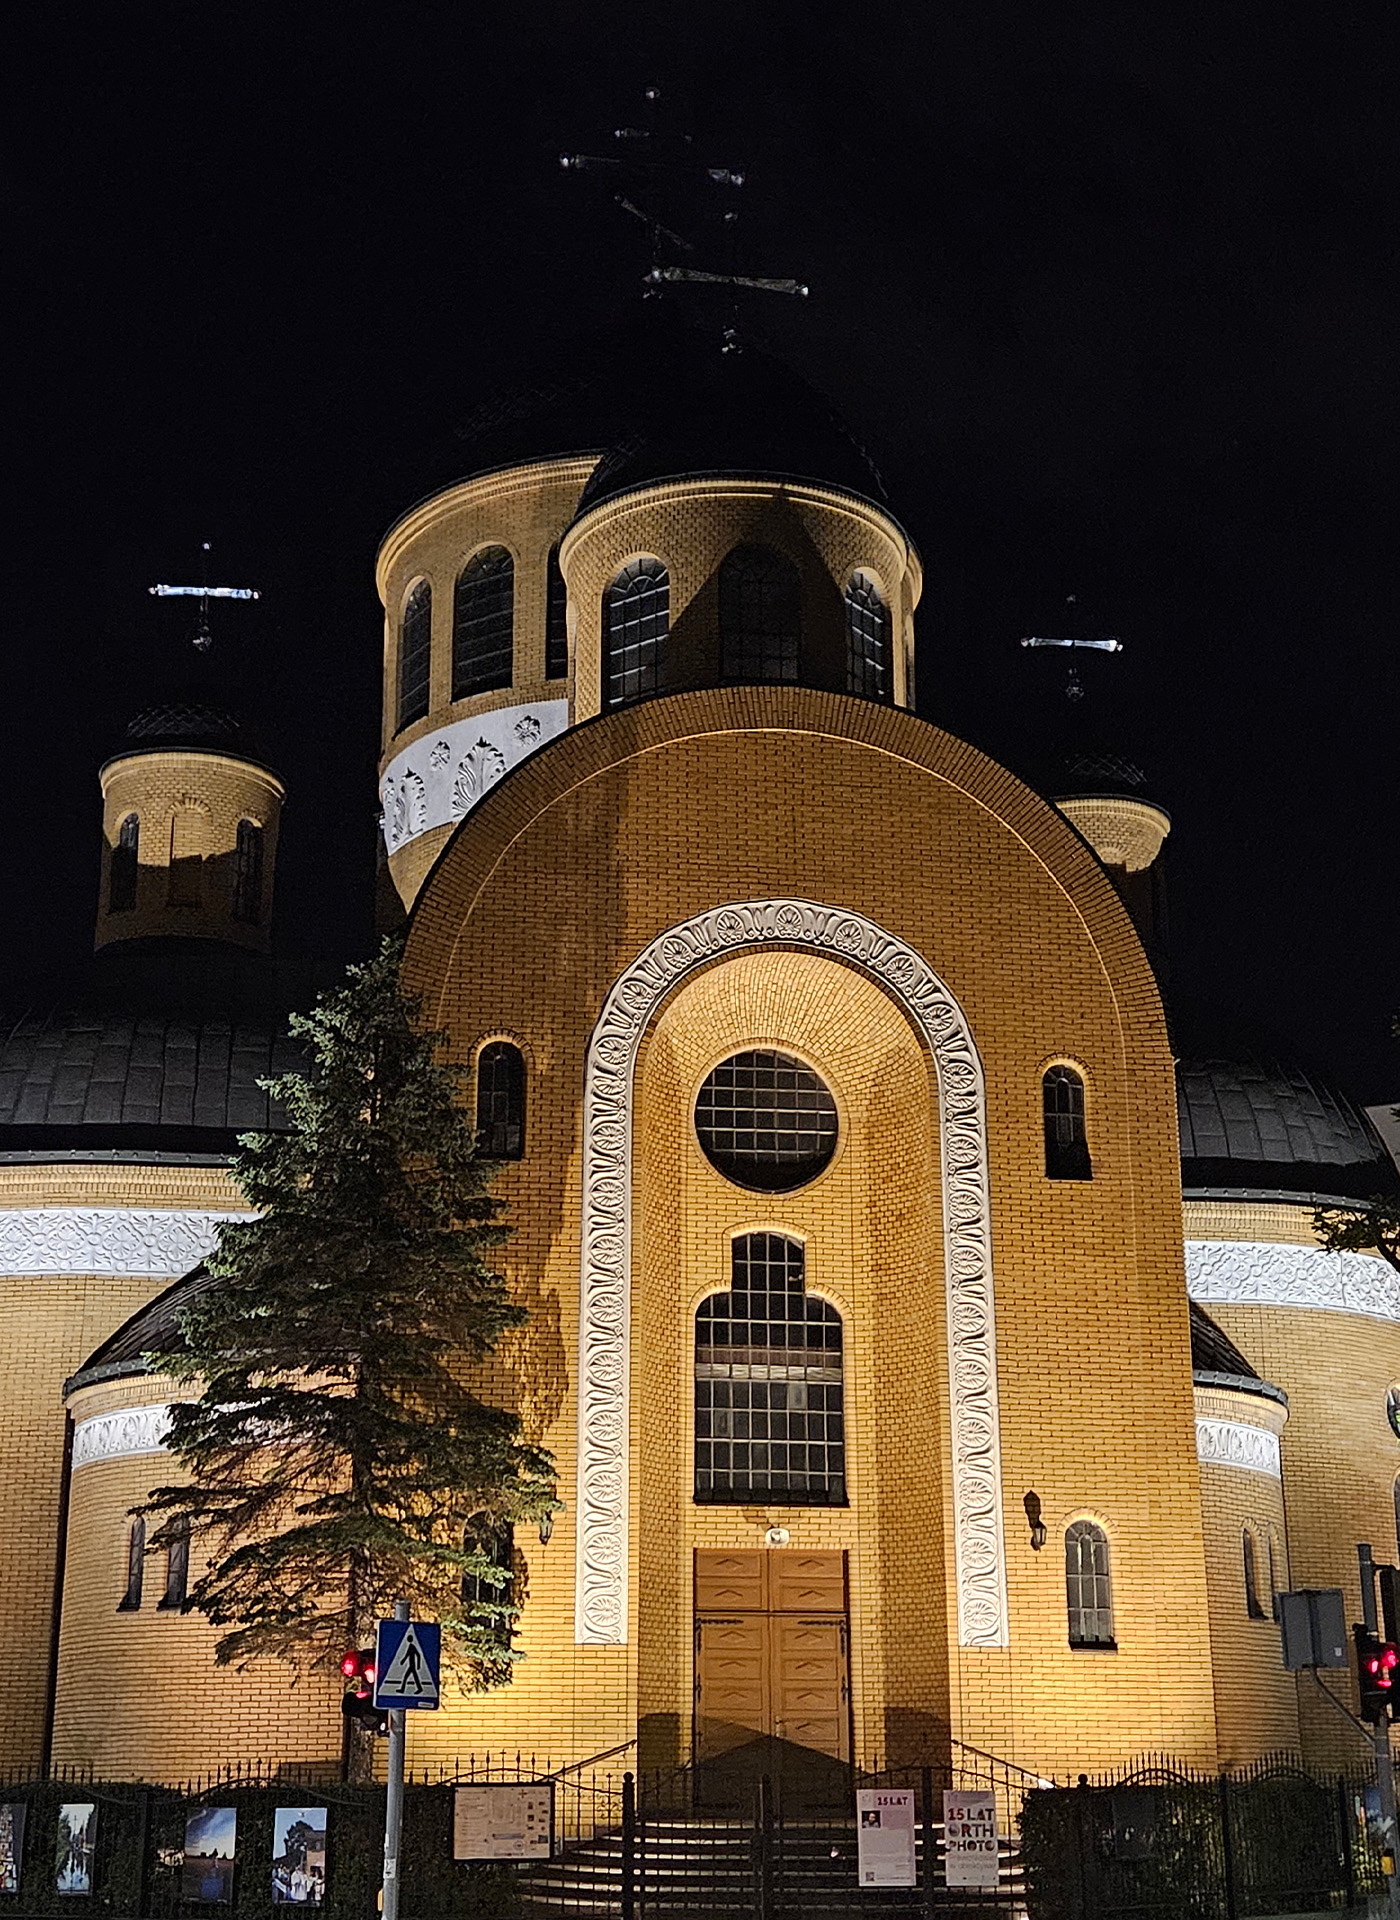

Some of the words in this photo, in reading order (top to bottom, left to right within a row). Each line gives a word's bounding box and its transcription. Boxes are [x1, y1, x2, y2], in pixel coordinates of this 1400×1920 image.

[877, 1796, 889, 1806] 15
[890, 1796, 908, 1806] LAT
[948, 1808, 964, 1821] 15
[967, 1808, 994, 1821] LAT
[948, 1823, 994, 1838] ORTH
[949, 1840, 995, 1852] PHOTO
